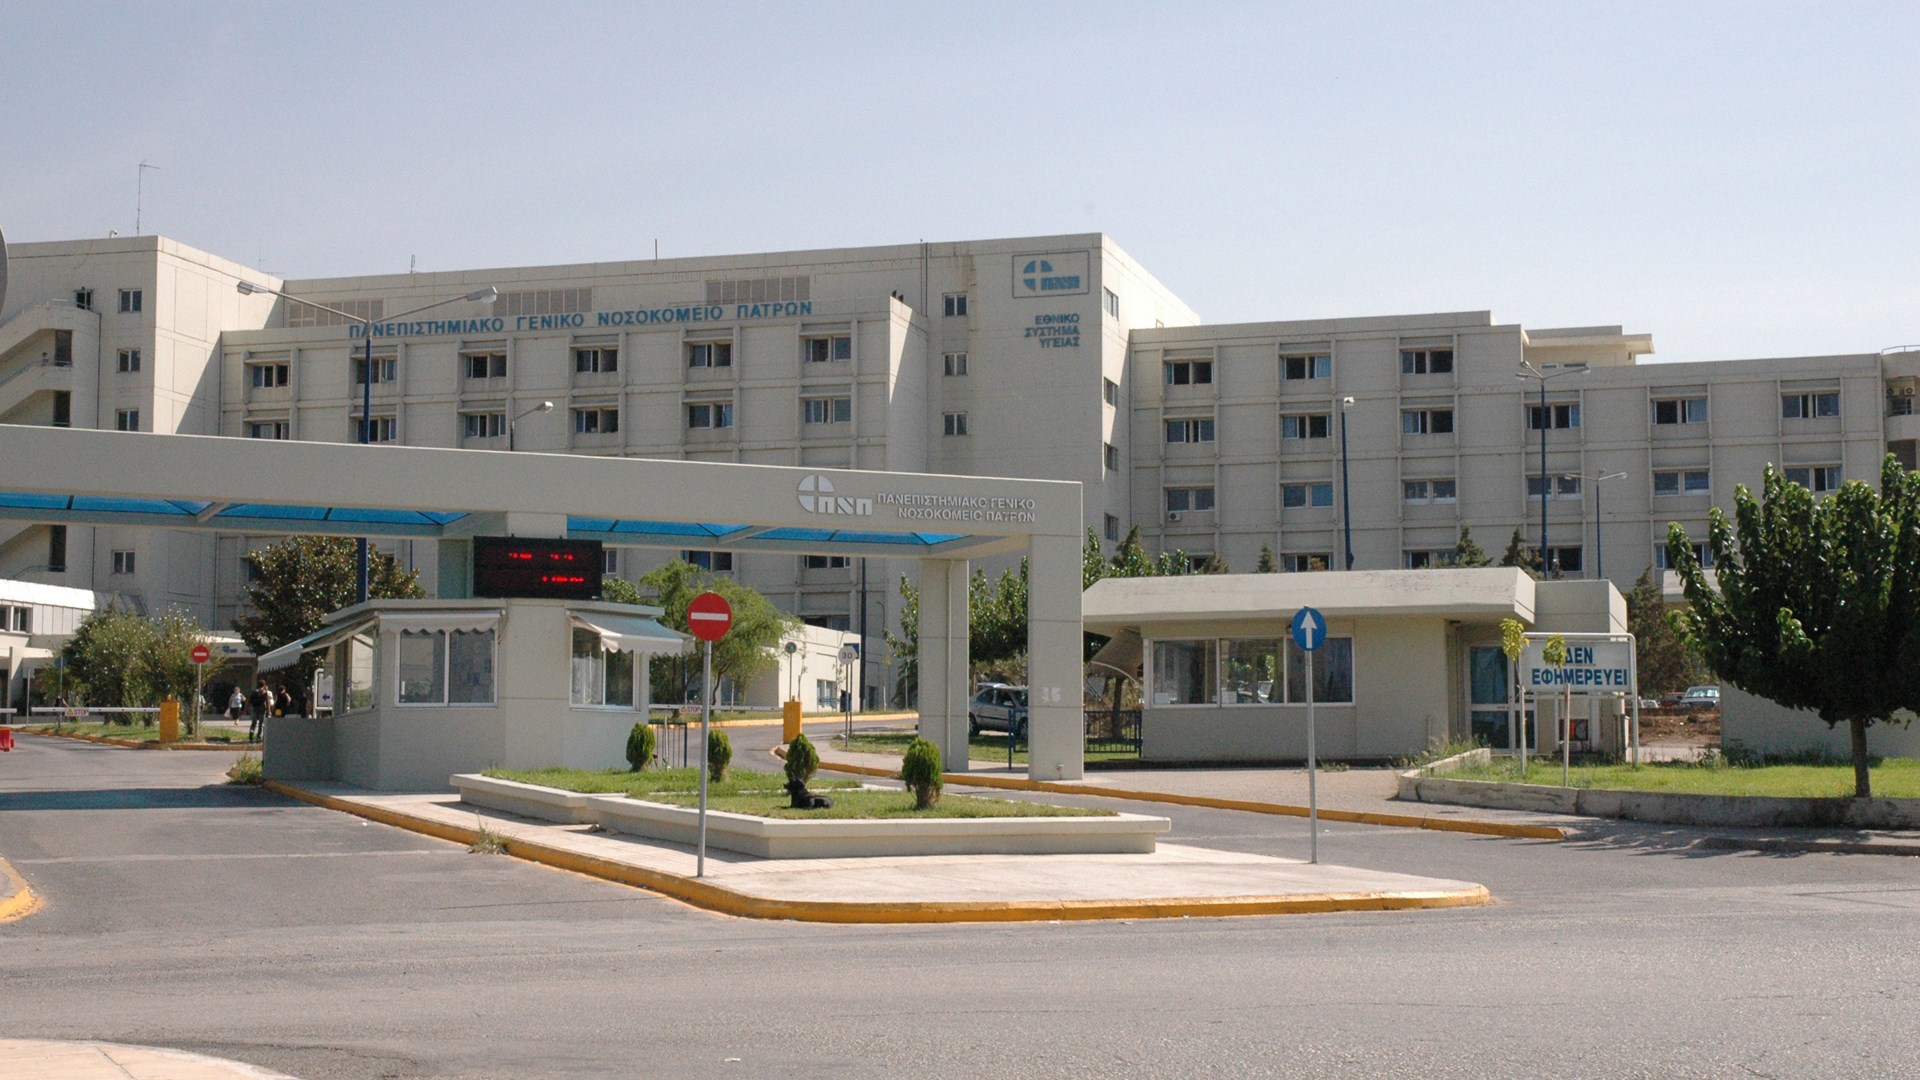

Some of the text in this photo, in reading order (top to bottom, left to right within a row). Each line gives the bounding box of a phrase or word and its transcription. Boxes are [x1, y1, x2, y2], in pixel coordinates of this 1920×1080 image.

[516, 312, 584, 330] ΓΕΝΙΚΟ
[598, 306, 723, 326] ΝΟΣΟΚΟΜΕΙΟ
[736, 300, 812, 318] ΠΑΤΡΩΝ
[1035, 313, 1080, 325] ΕΘΝΙΚΟ
[1024, 325, 1080, 337] ΣΥΣΤΗΜΑ
[1040, 337, 1080, 348] ΥΓΕΙΑΣ
[877, 493, 1035, 510] ΠΑΝΕΠΙΣΤΗΜΙΑΚΟ ΓΕΝΙΚΟ
[898, 507, 1035, 523] ΝΟΣΟΚΟΜΕΙΟ ΠΑΤΡΩΝ
[842, 651, 853, 659] 30
[1565, 647, 1593, 664] ΔΕΝ
[1532, 668, 1628, 685] ΕΦΗΜΕΡΕΥΕΙ
